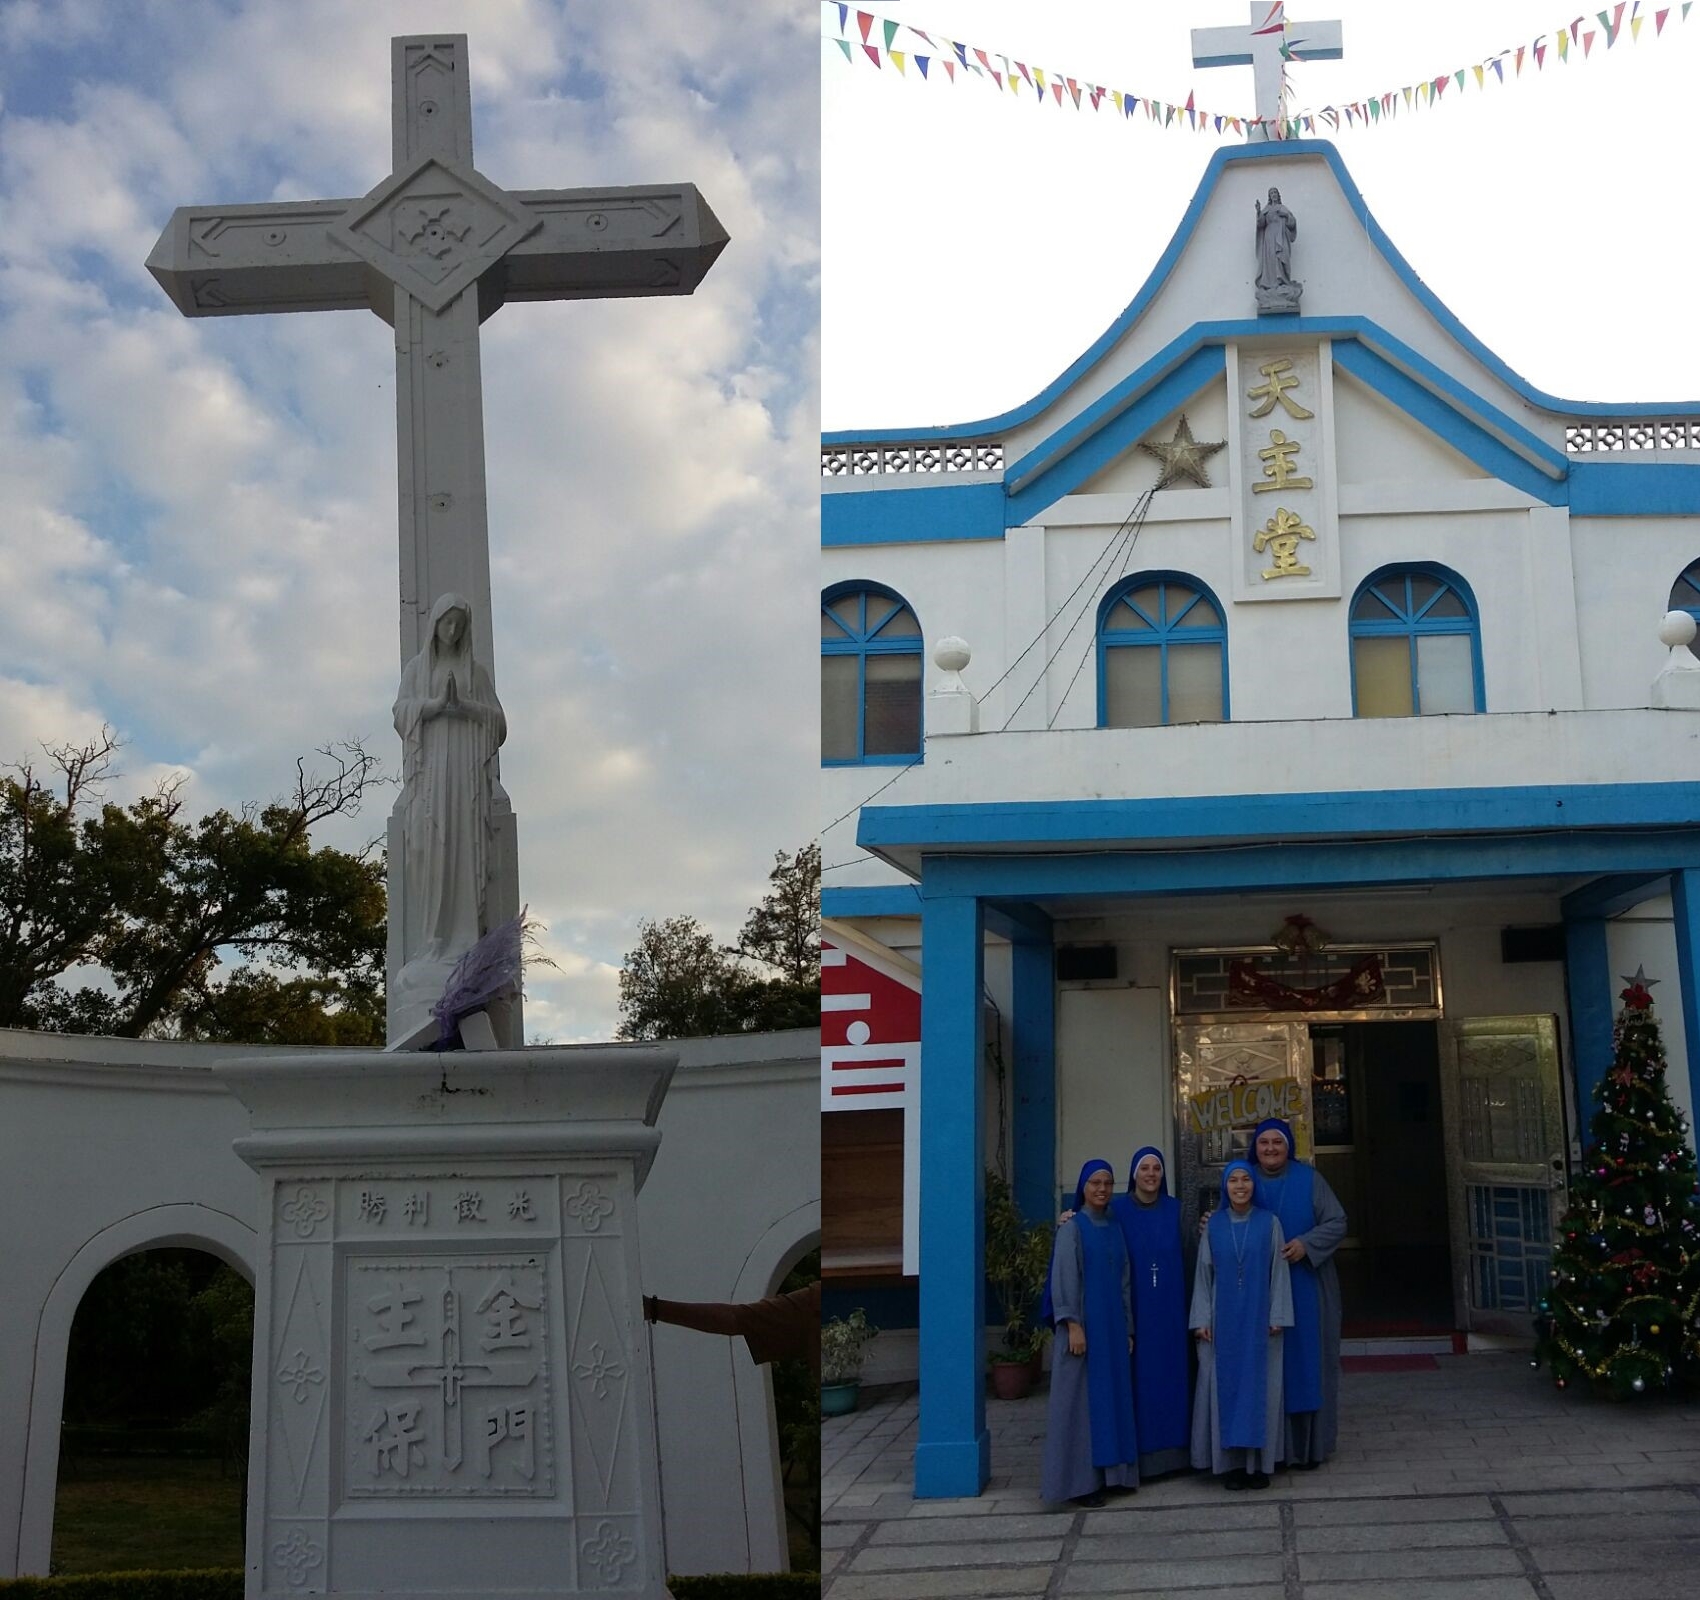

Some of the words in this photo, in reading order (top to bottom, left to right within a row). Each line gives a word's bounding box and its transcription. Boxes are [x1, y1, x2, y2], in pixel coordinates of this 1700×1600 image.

[1247, 358, 1315, 580] 天主堂
[1190, 1081, 1302, 1130] WELCOME
[363, 1281, 428, 1479] 主保
[474, 1273, 543, 1480] 金門
